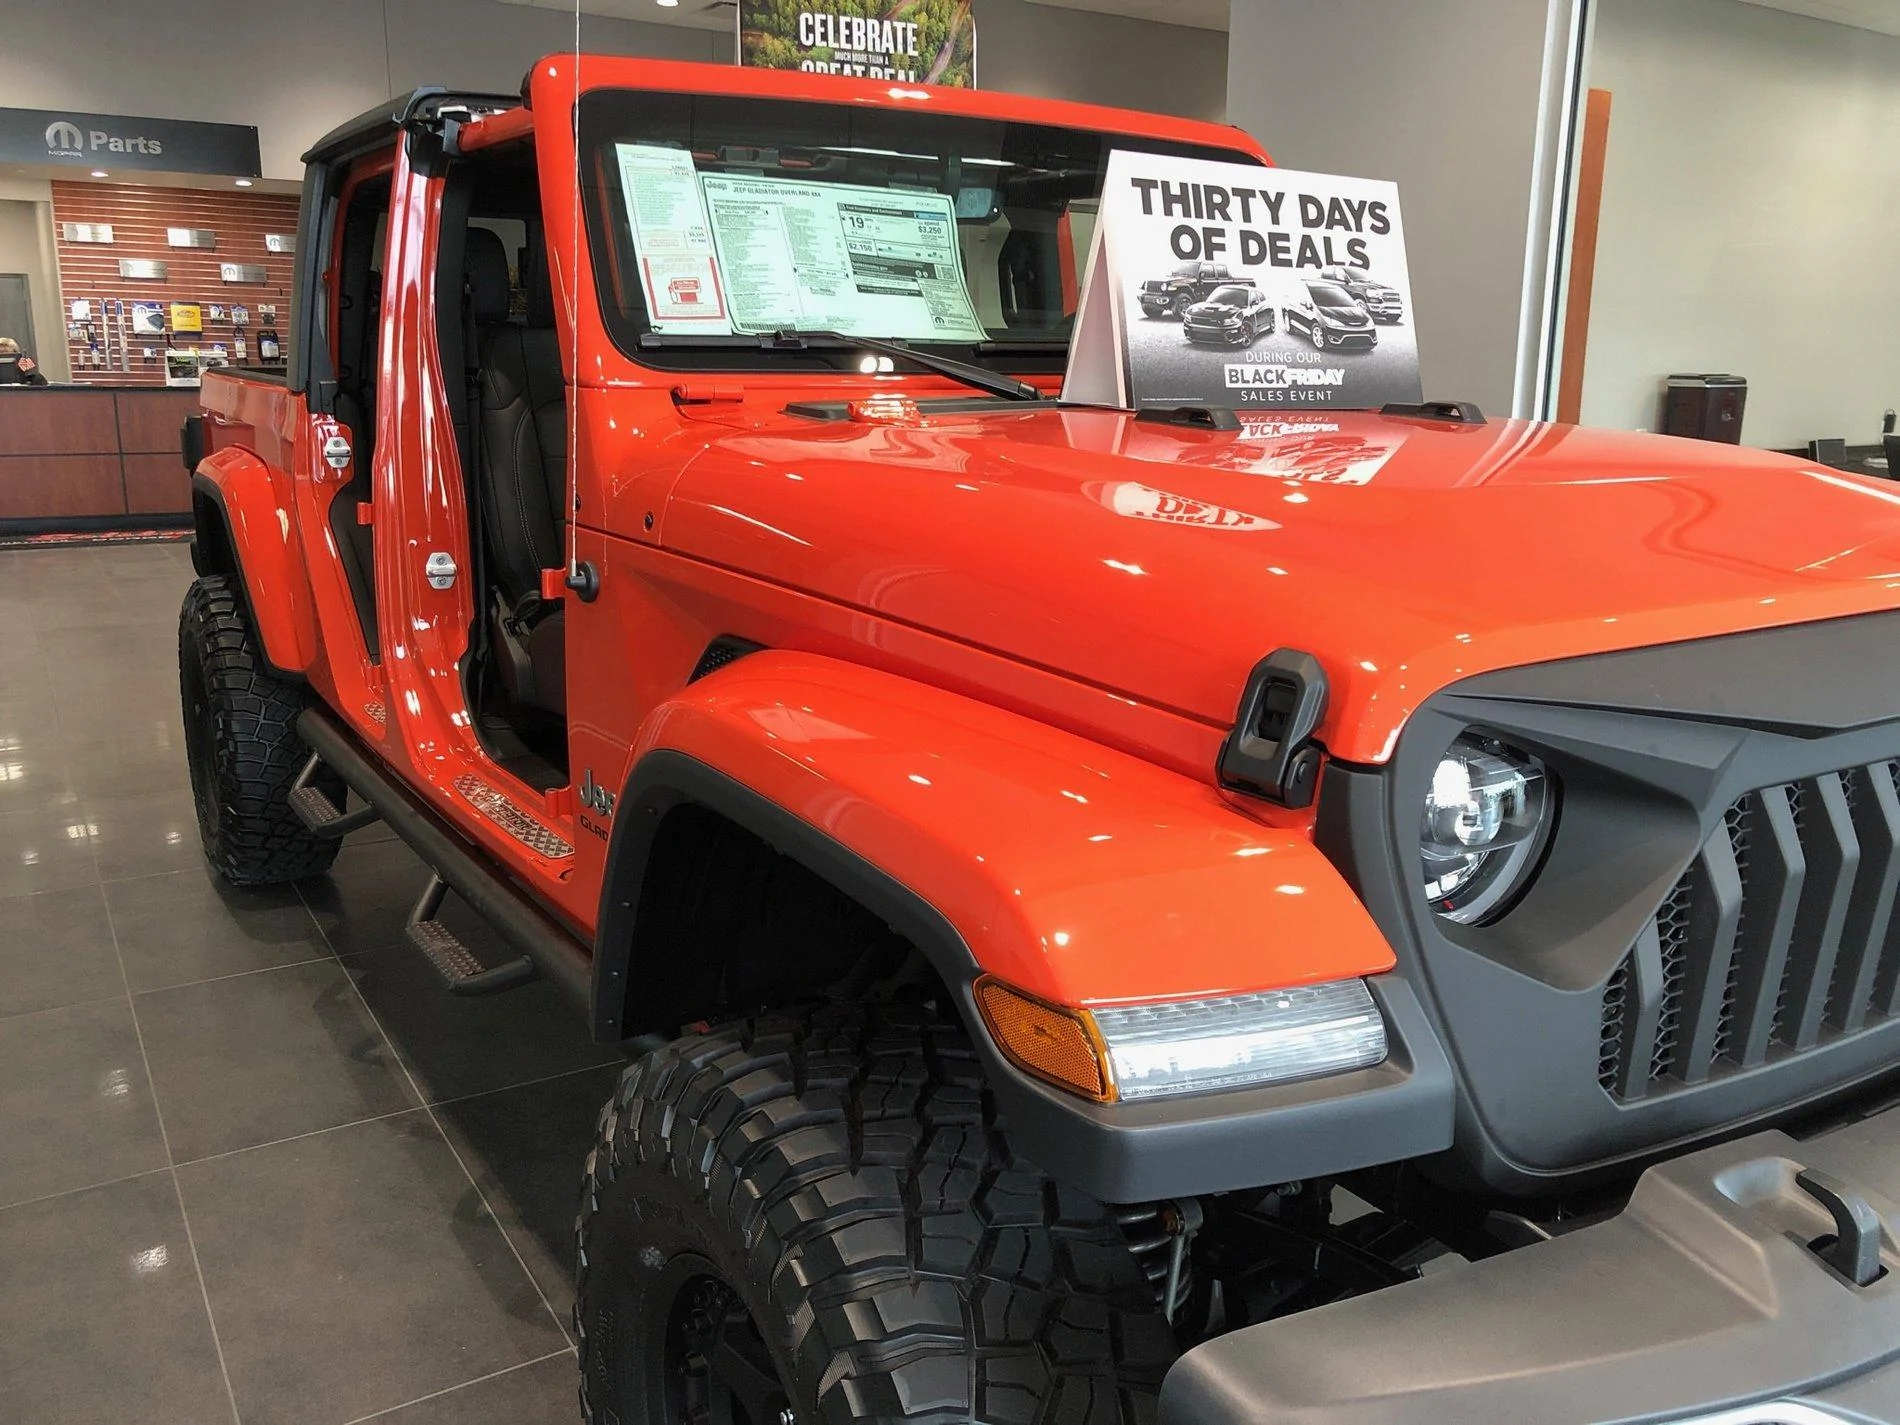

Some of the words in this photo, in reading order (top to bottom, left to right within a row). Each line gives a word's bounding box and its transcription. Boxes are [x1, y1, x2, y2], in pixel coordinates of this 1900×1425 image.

[800, 12, 919, 57] CELEBRATE
[834, 51, 852, 61] MUCH
[852, 53, 869, 64] MORE
[869, 54, 884, 65] THAN
[884, 56, 889, 66] A
[89, 131, 162, 155] Parts
[706, 181, 728, 191] Jeep
[747, 188, 780, 196] GLADIATOR
[780, 189, 810, 197] OVERLAND
[1131, 177, 1286, 226] THIRTY
[1298, 194, 1391, 236] DAYS
[848, 216, 864, 229] 19
[918, 226, 942, 235] $3,250
[848, 242, 873, 252] $2,150
[1170, 224, 1226, 261] OF
[1239, 229, 1371, 270] DEALS
[1245, 352, 1292, 363] DURING
[1296, 353, 1322, 363] OUR
[1228, 368, 1287, 385] BLACK
[1286, 368, 1345, 386] FRIDAY
[1240, 390, 1283, 401] SALES
[1290, 391, 1332, 401] EVENT
